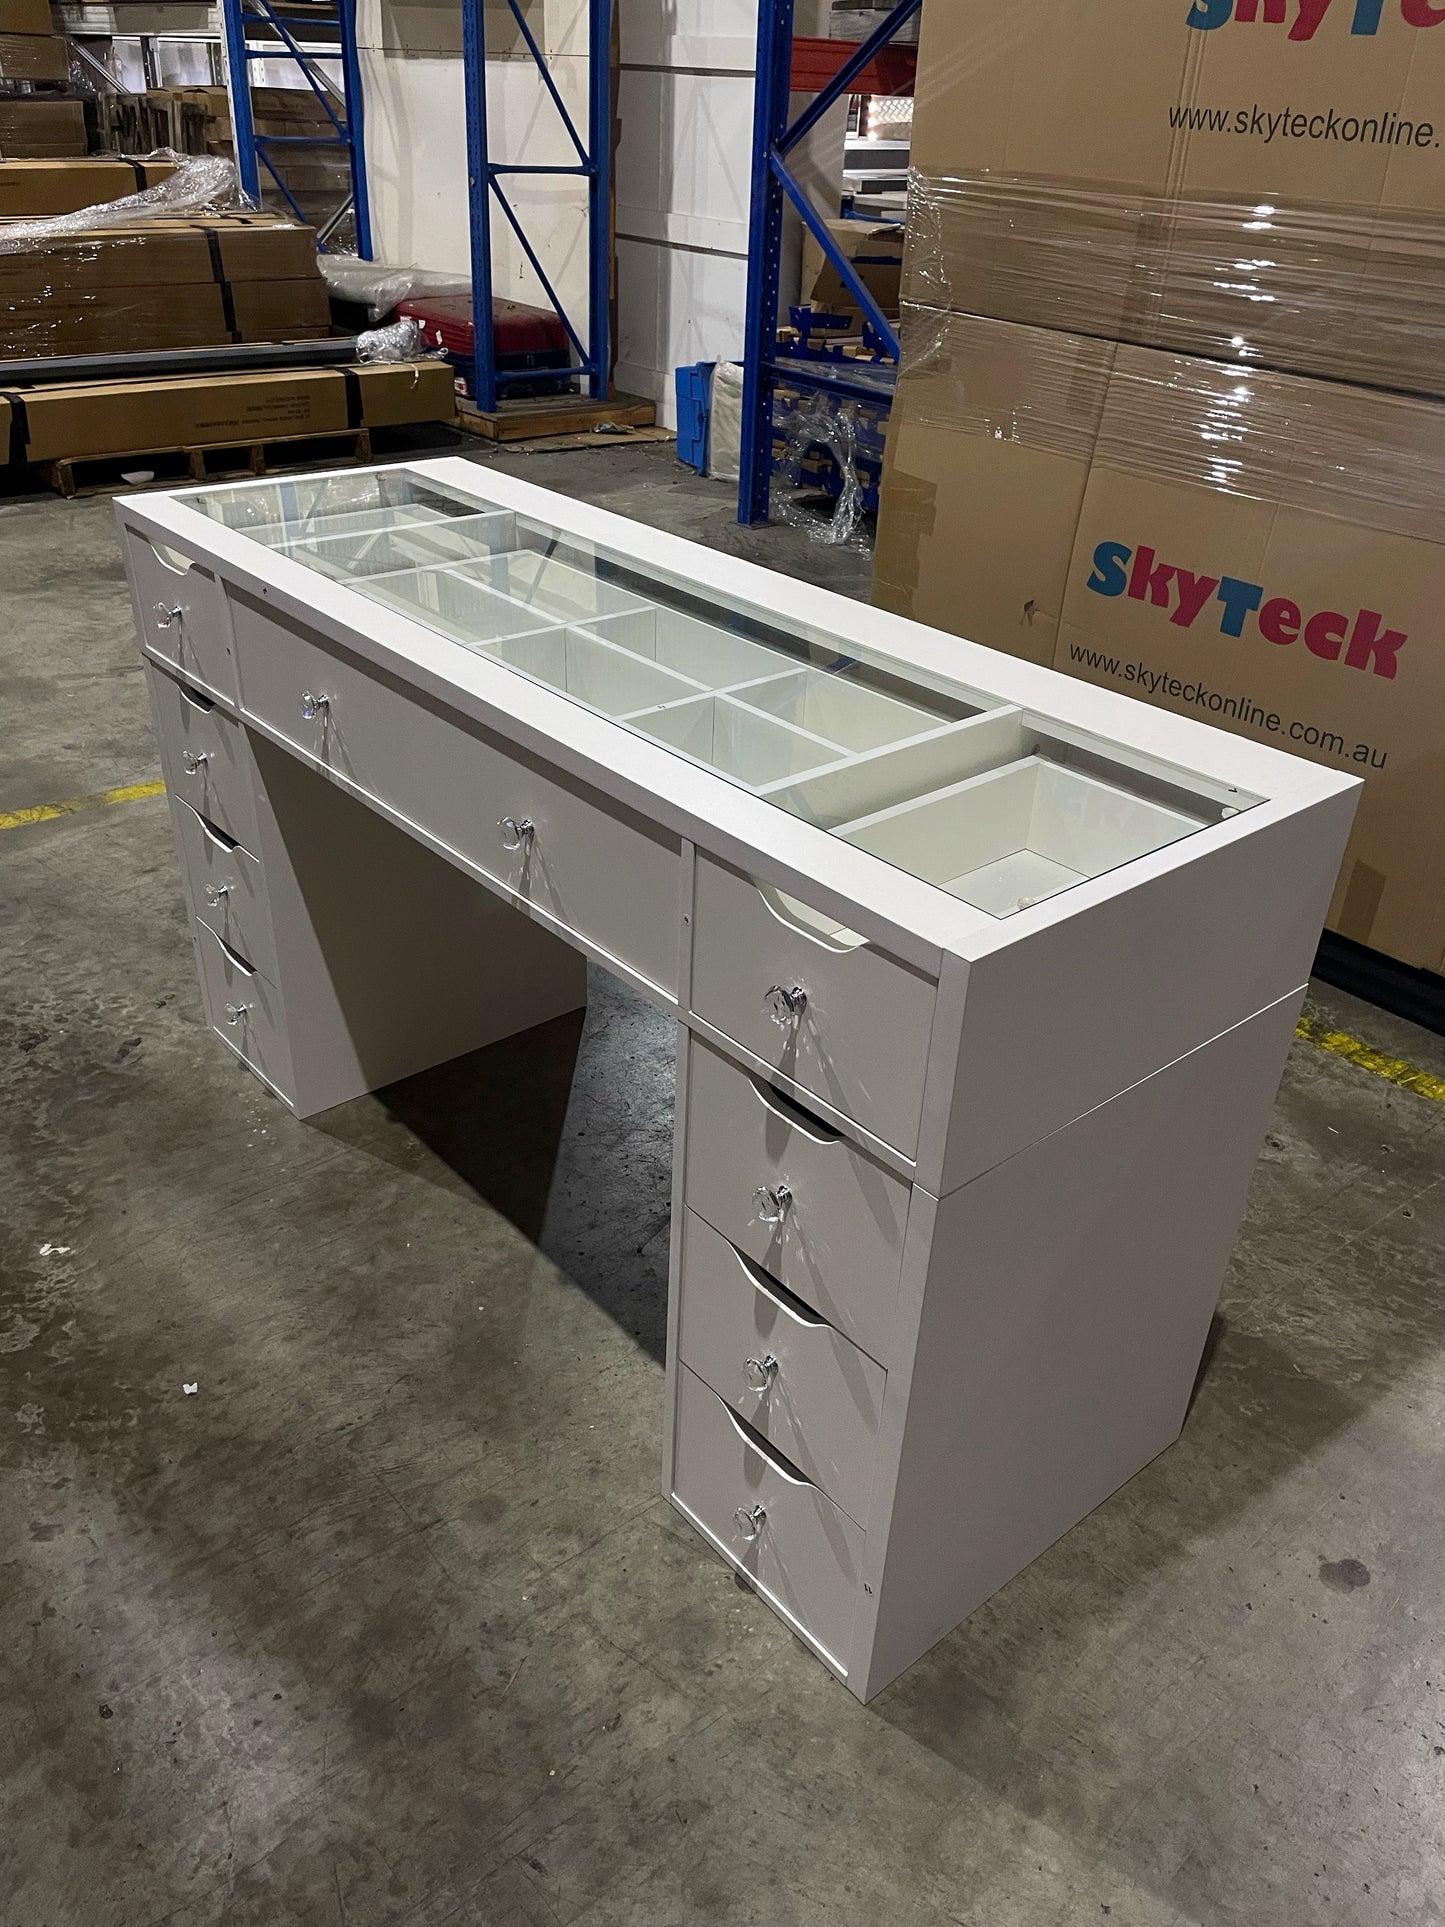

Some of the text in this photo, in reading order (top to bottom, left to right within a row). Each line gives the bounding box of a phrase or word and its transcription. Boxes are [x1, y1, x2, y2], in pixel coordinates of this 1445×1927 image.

[1169, 104, 1440, 148] www.skyteckonline.
[1086, 541, 1408, 680] SkyTeck
[1069, 643, 1388, 769] www.skyteckonline.com.au
